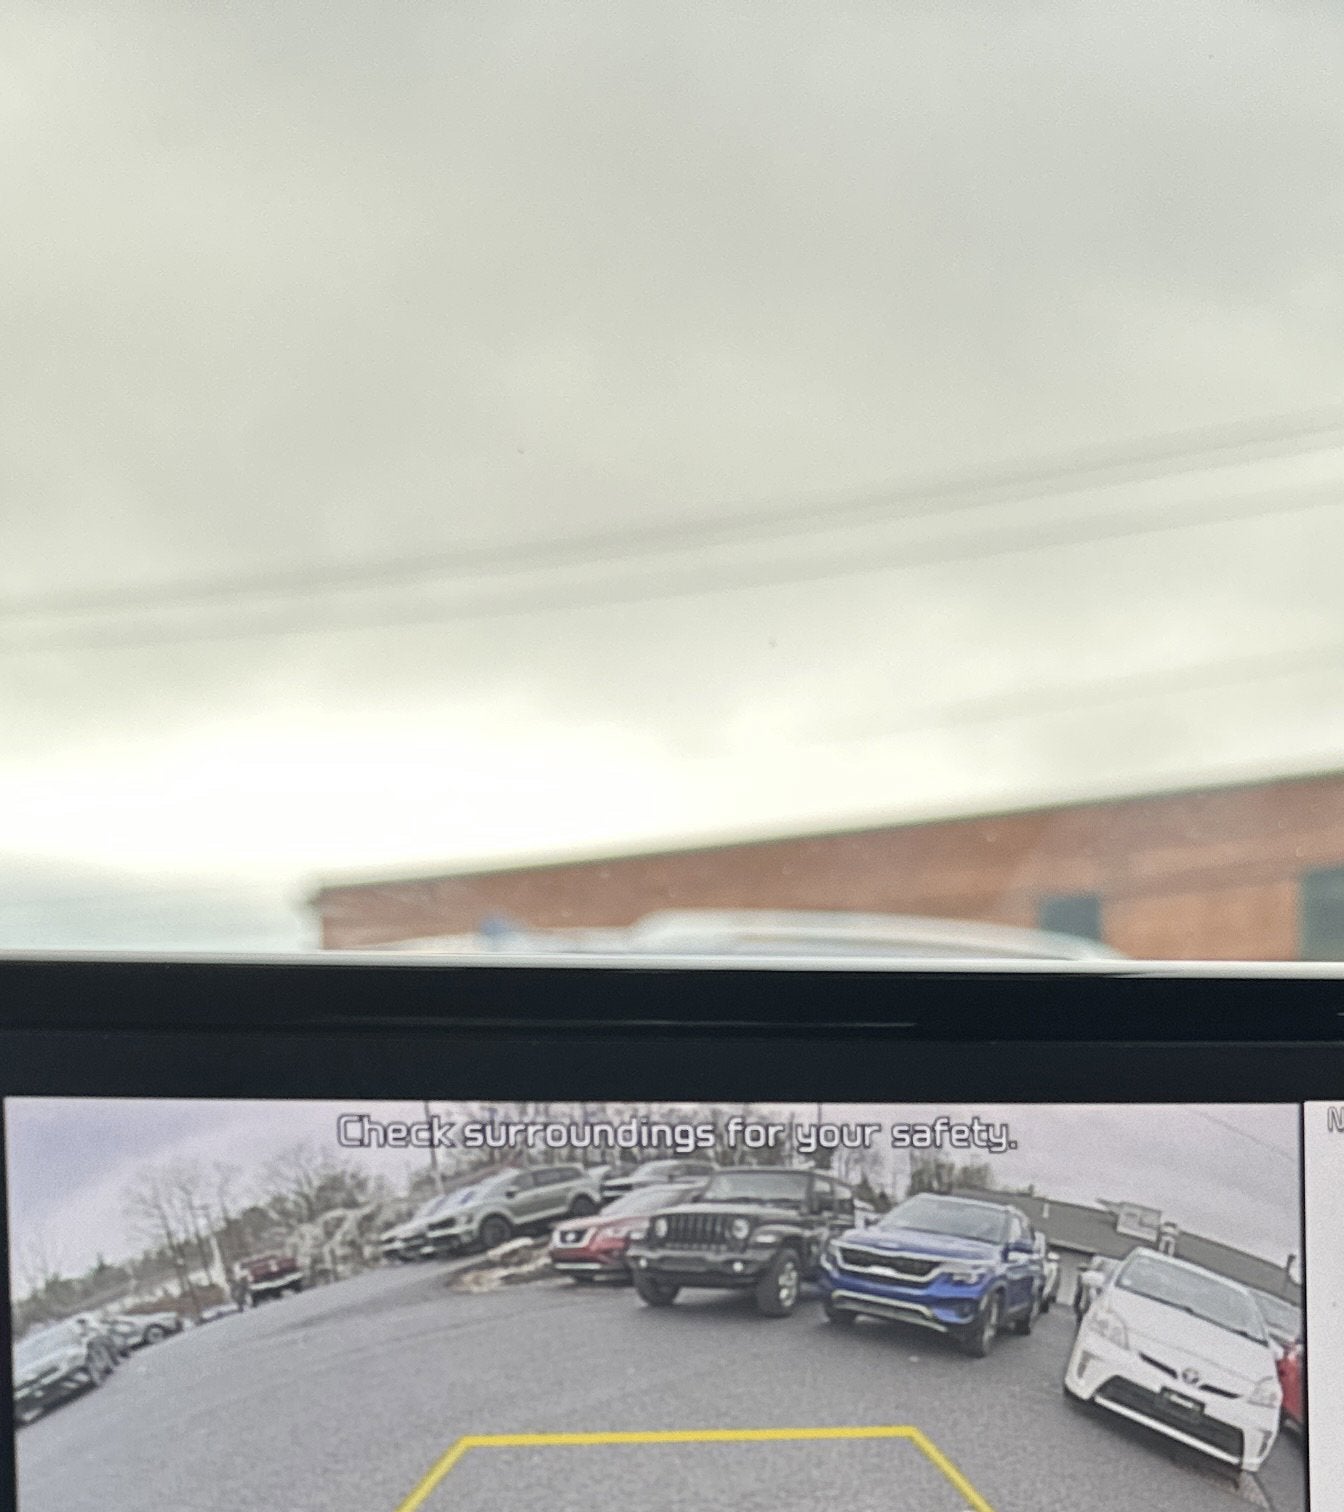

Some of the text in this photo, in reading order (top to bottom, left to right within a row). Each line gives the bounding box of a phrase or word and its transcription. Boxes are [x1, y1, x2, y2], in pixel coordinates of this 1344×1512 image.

[337, 1114, 1018, 1153] Check surroundings for your safety.
